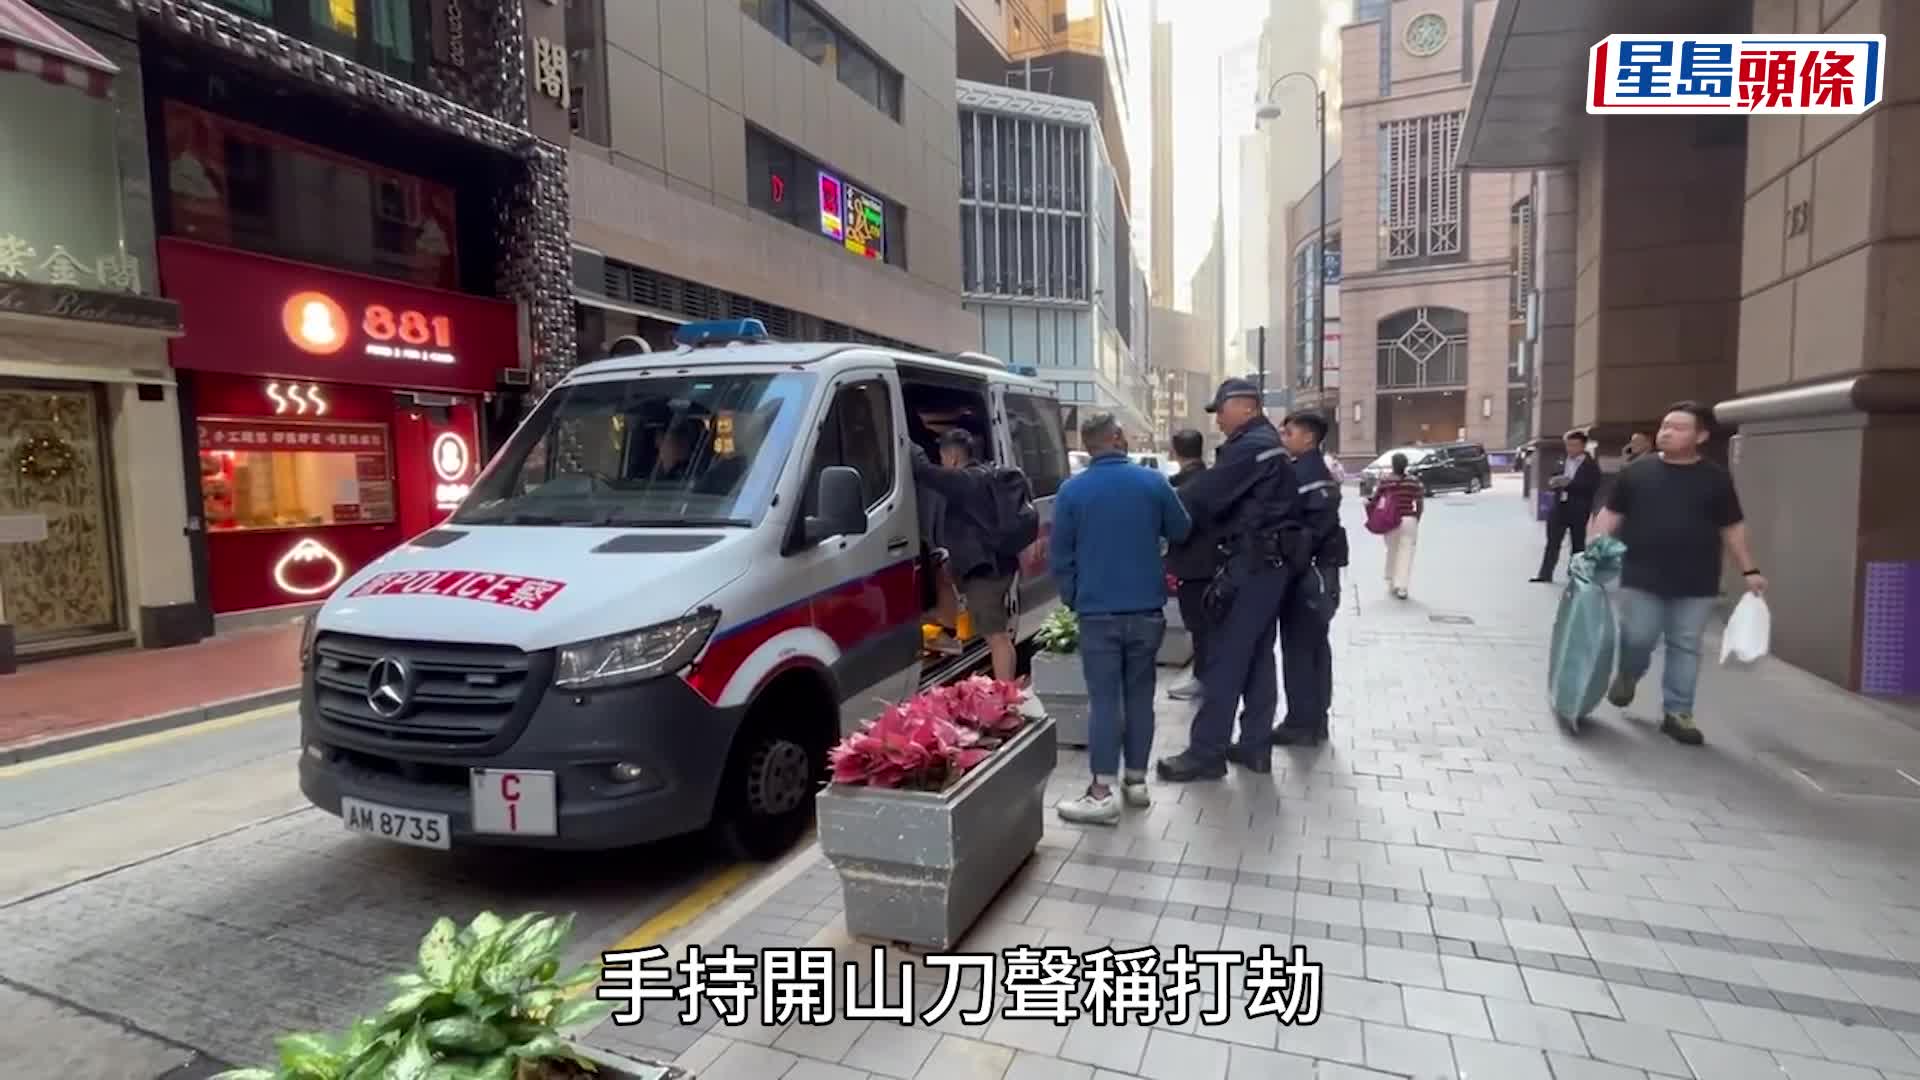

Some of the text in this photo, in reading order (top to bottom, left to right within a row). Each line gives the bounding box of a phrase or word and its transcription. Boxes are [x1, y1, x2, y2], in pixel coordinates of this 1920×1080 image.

[533, 0, 570, 110] 閣
[362, 304, 452, 347] 881
[501, 773, 521, 801] C
[349, 804, 441, 843] AM 8735
[507, 803, 517, 832] 1
